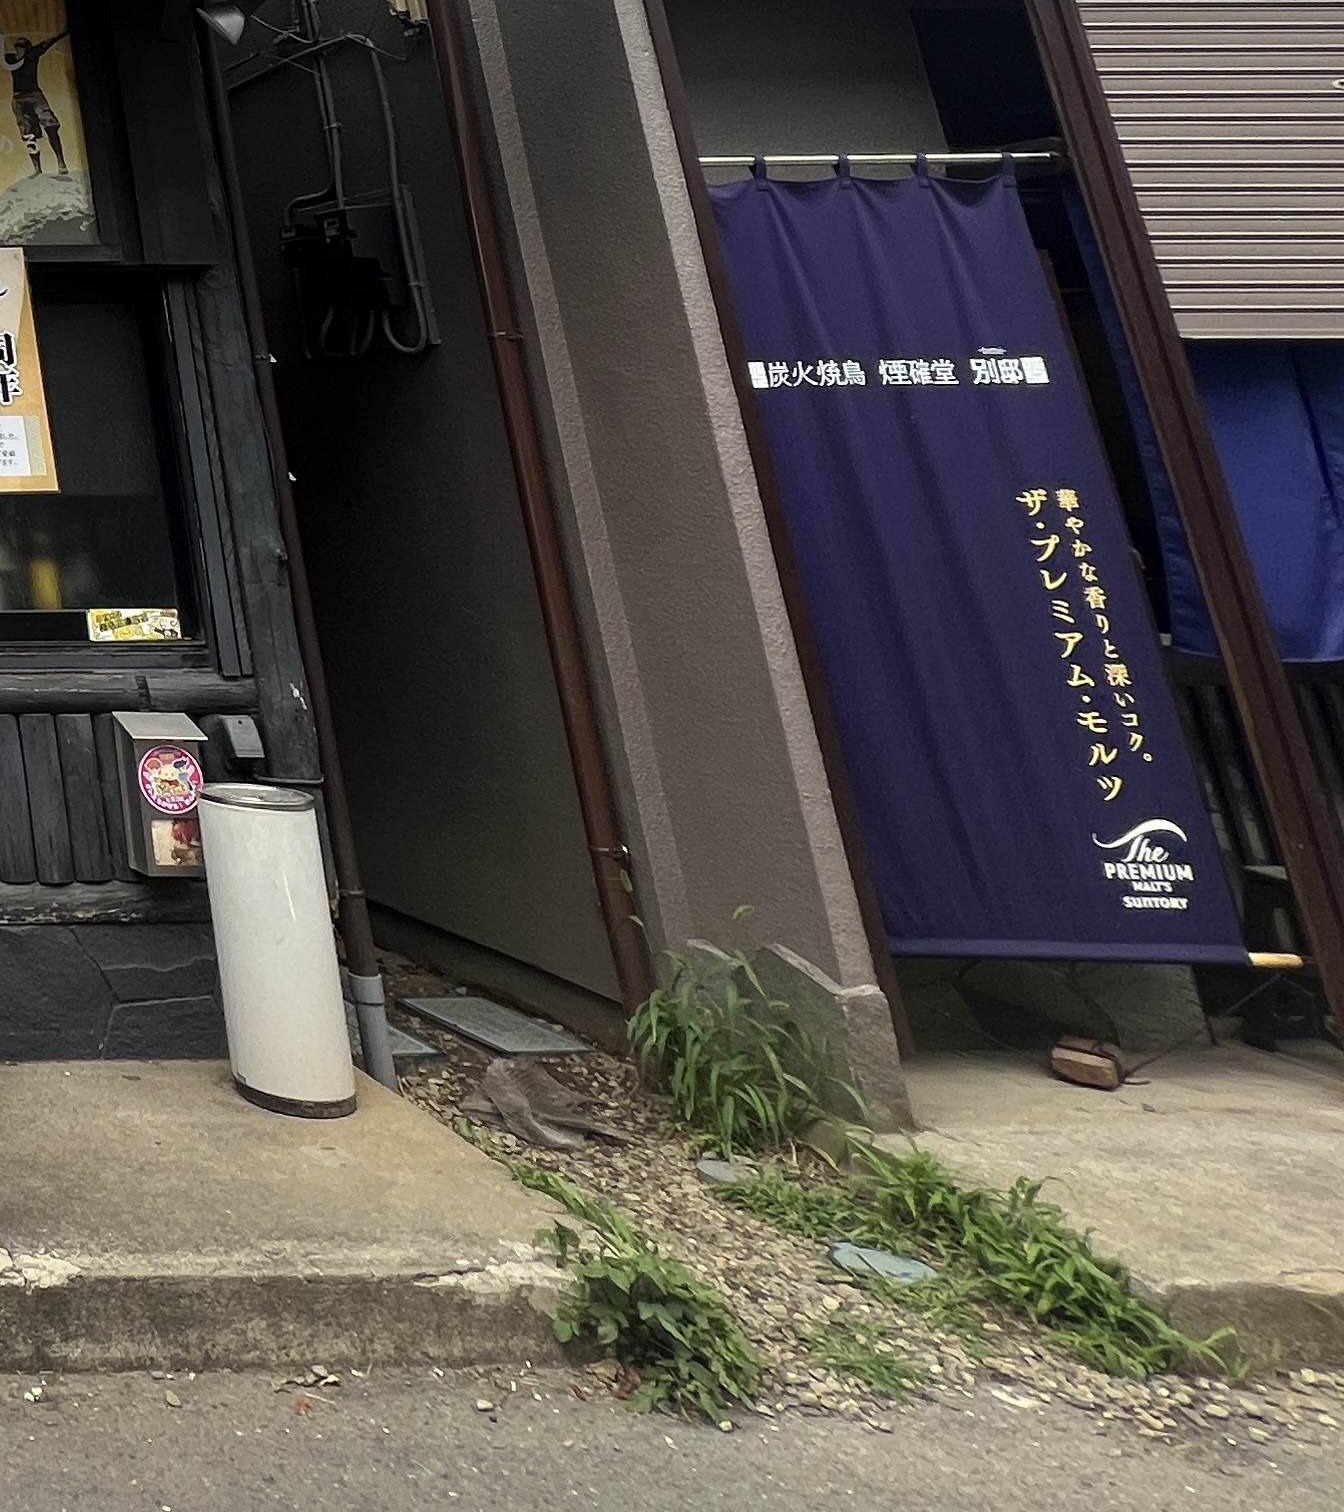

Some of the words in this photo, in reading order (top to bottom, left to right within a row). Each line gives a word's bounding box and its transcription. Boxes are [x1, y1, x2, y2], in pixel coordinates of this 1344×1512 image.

[768, 359, 865, 387] 炭火焼鳥
[1015, 488, 1123, 802] ザ・プレミアム・モルツ
[1056, 488, 1153, 763] 華やかな香りと深いコク。
[1103, 862, 1194, 881] PREMIUM
